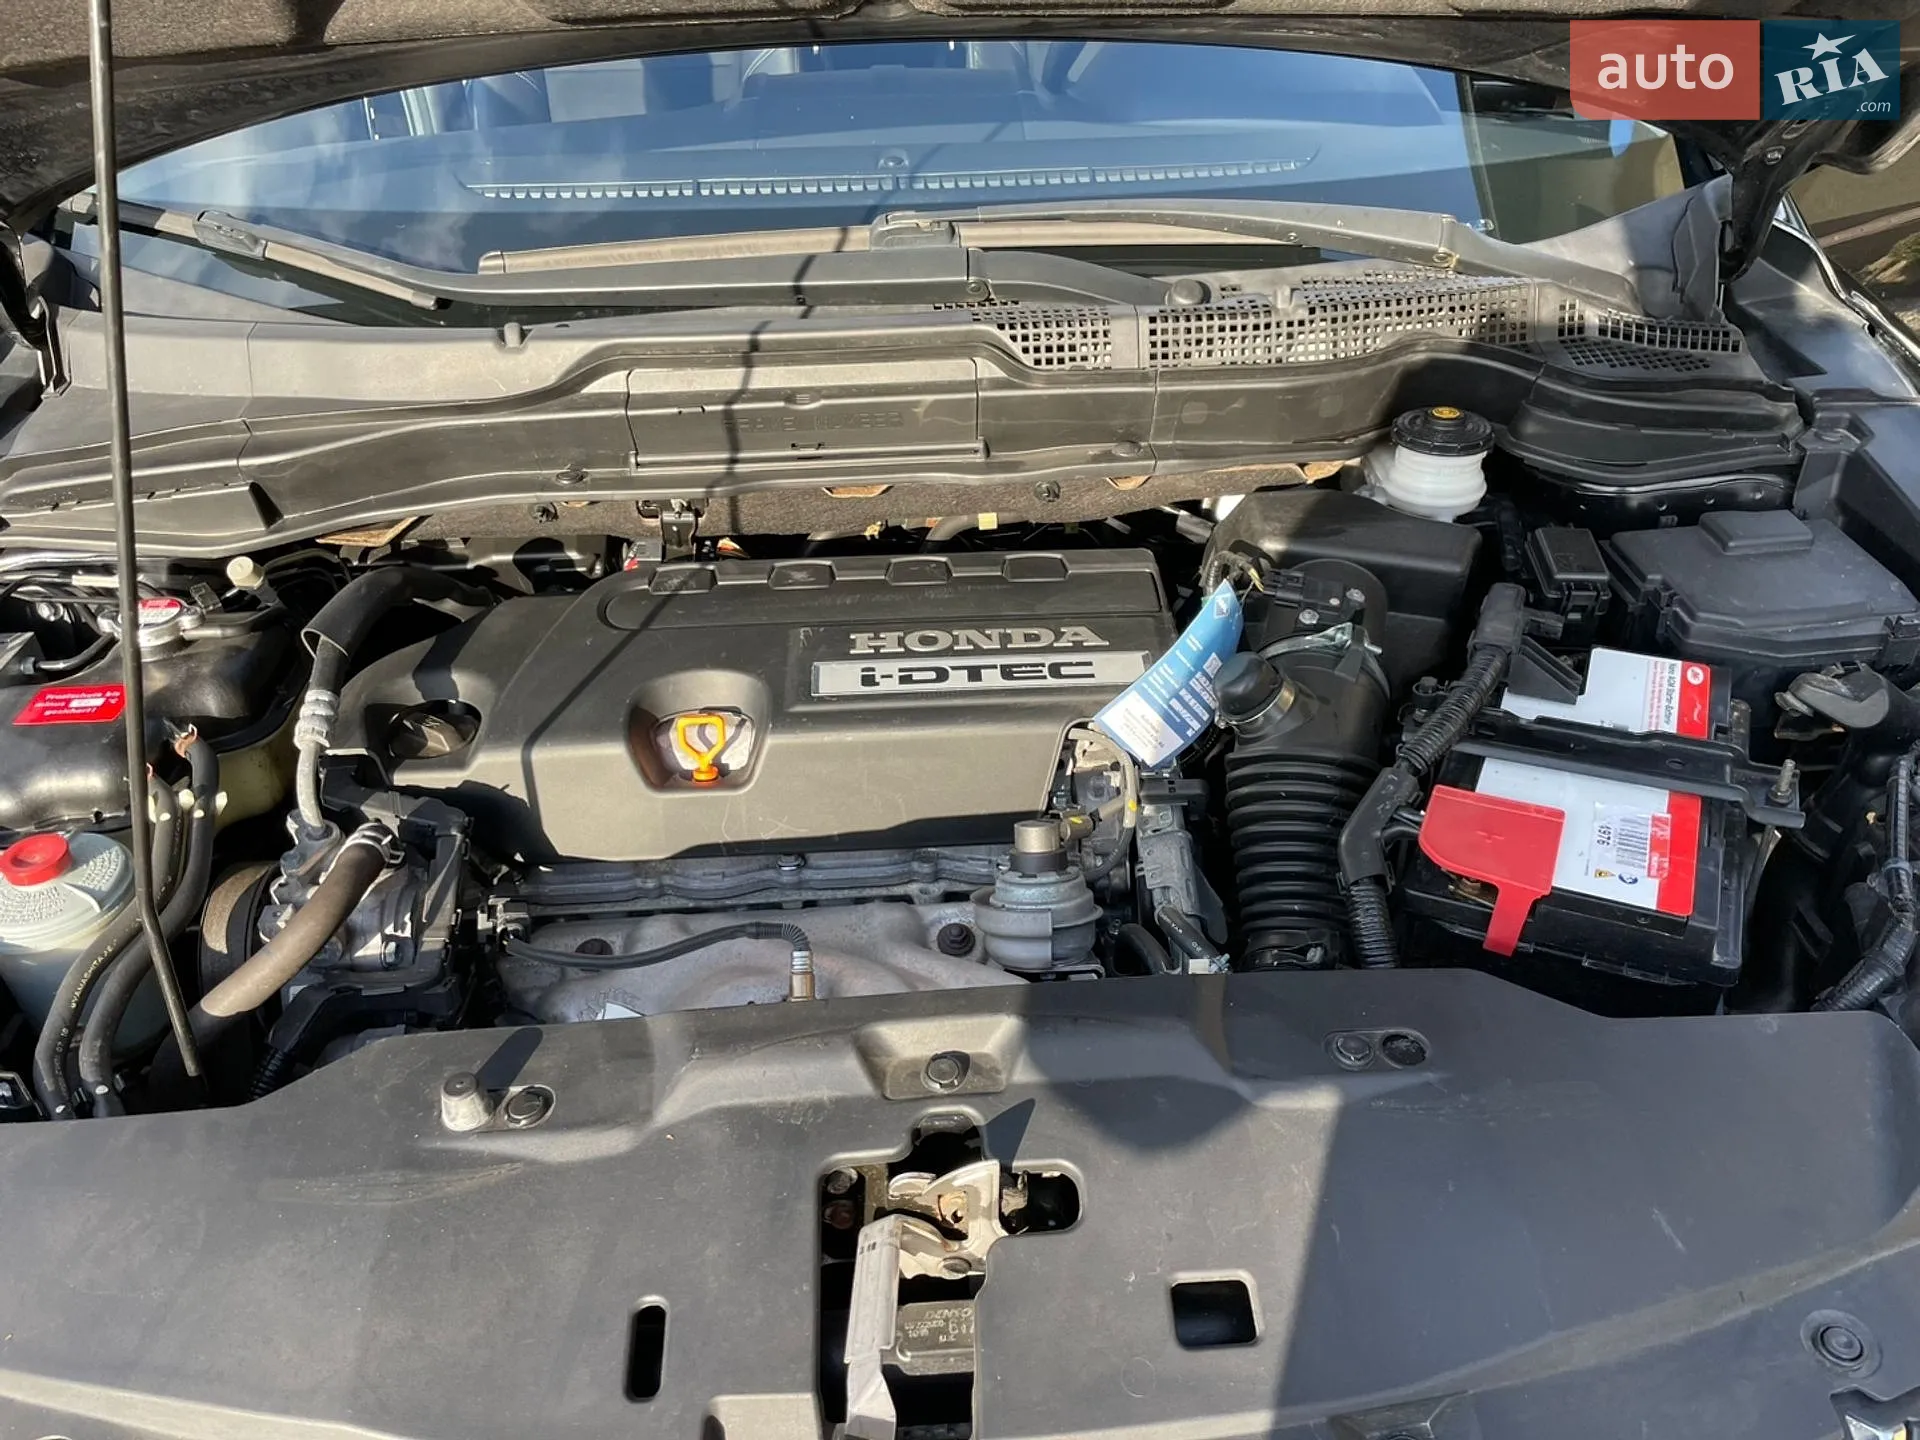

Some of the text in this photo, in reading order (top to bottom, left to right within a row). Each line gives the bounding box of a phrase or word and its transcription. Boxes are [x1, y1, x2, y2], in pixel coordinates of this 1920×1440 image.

[723, 412, 905, 433] FRAME NUMBER
[849, 625, 1110, 654] HONDA
[860, 661, 1095, 687] i-DTEC
